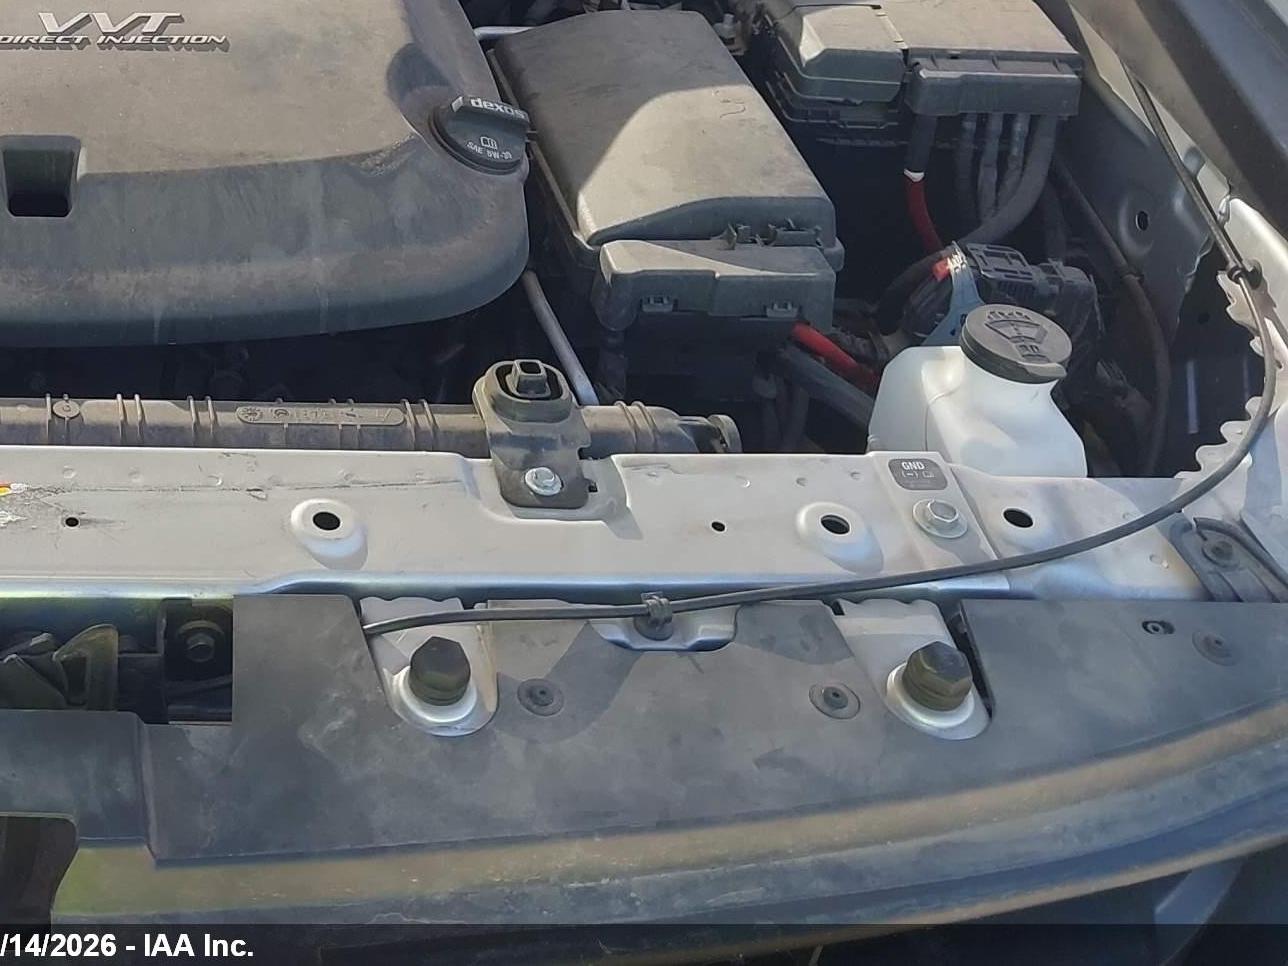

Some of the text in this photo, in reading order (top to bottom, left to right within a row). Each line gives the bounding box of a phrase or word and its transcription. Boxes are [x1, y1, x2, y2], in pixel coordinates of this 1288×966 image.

[39, 11, 183, 35] VVT
[97, 35, 227, 48] INJECTION
[470, 97, 526, 119] dexos
[467, 141, 483, 154] SAE
[901, 461, 925, 470] GND
